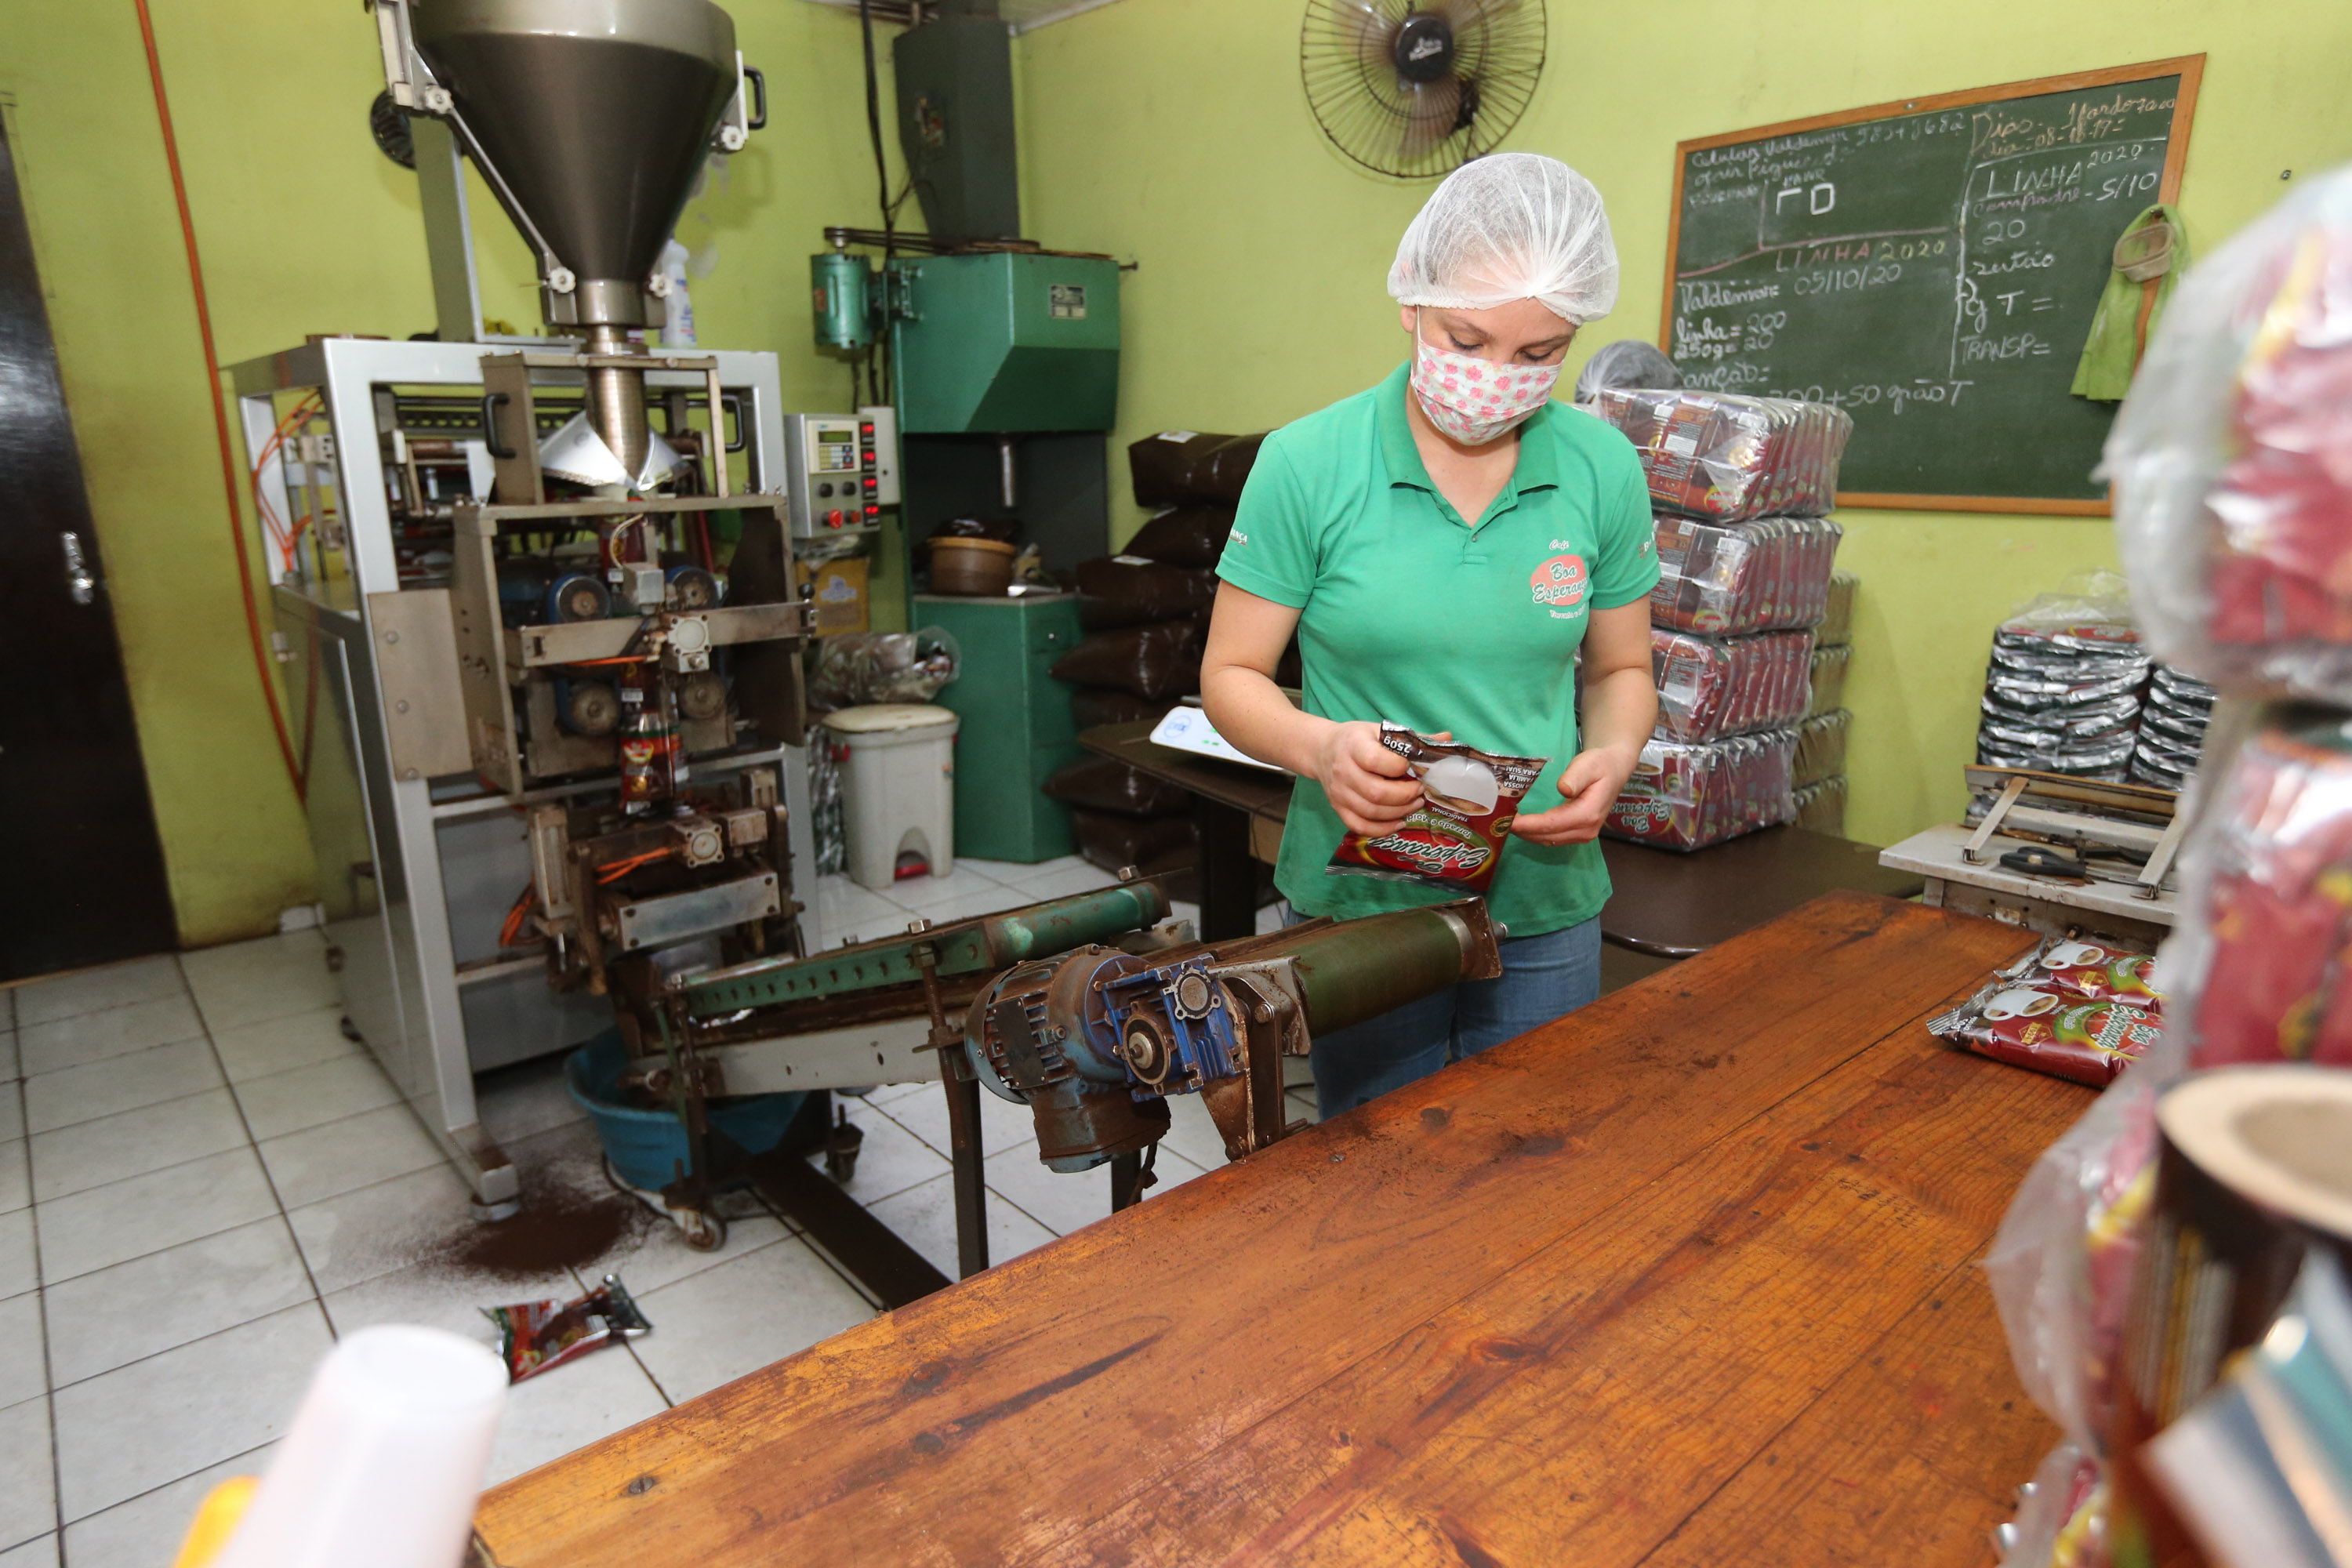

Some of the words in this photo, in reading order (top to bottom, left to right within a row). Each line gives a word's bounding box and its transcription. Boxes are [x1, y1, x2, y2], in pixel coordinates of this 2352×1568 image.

[1987, 162, 2082, 198] LINHA
[1982, 219, 2026, 245] 20
[1776, 241, 1871, 274] LINHA
[1879, 240, 1947, 262] 2020
[1550, 561, 1577, 582] Boa
[1383, 735, 1412, 753] 250g
[1504, 780, 1525, 789] NOSSA
[1432, 807, 1468, 822] TRADICIONAL
[1439, 820, 1472, 839] Torrado
[1621, 816, 1650, 833] Boa
